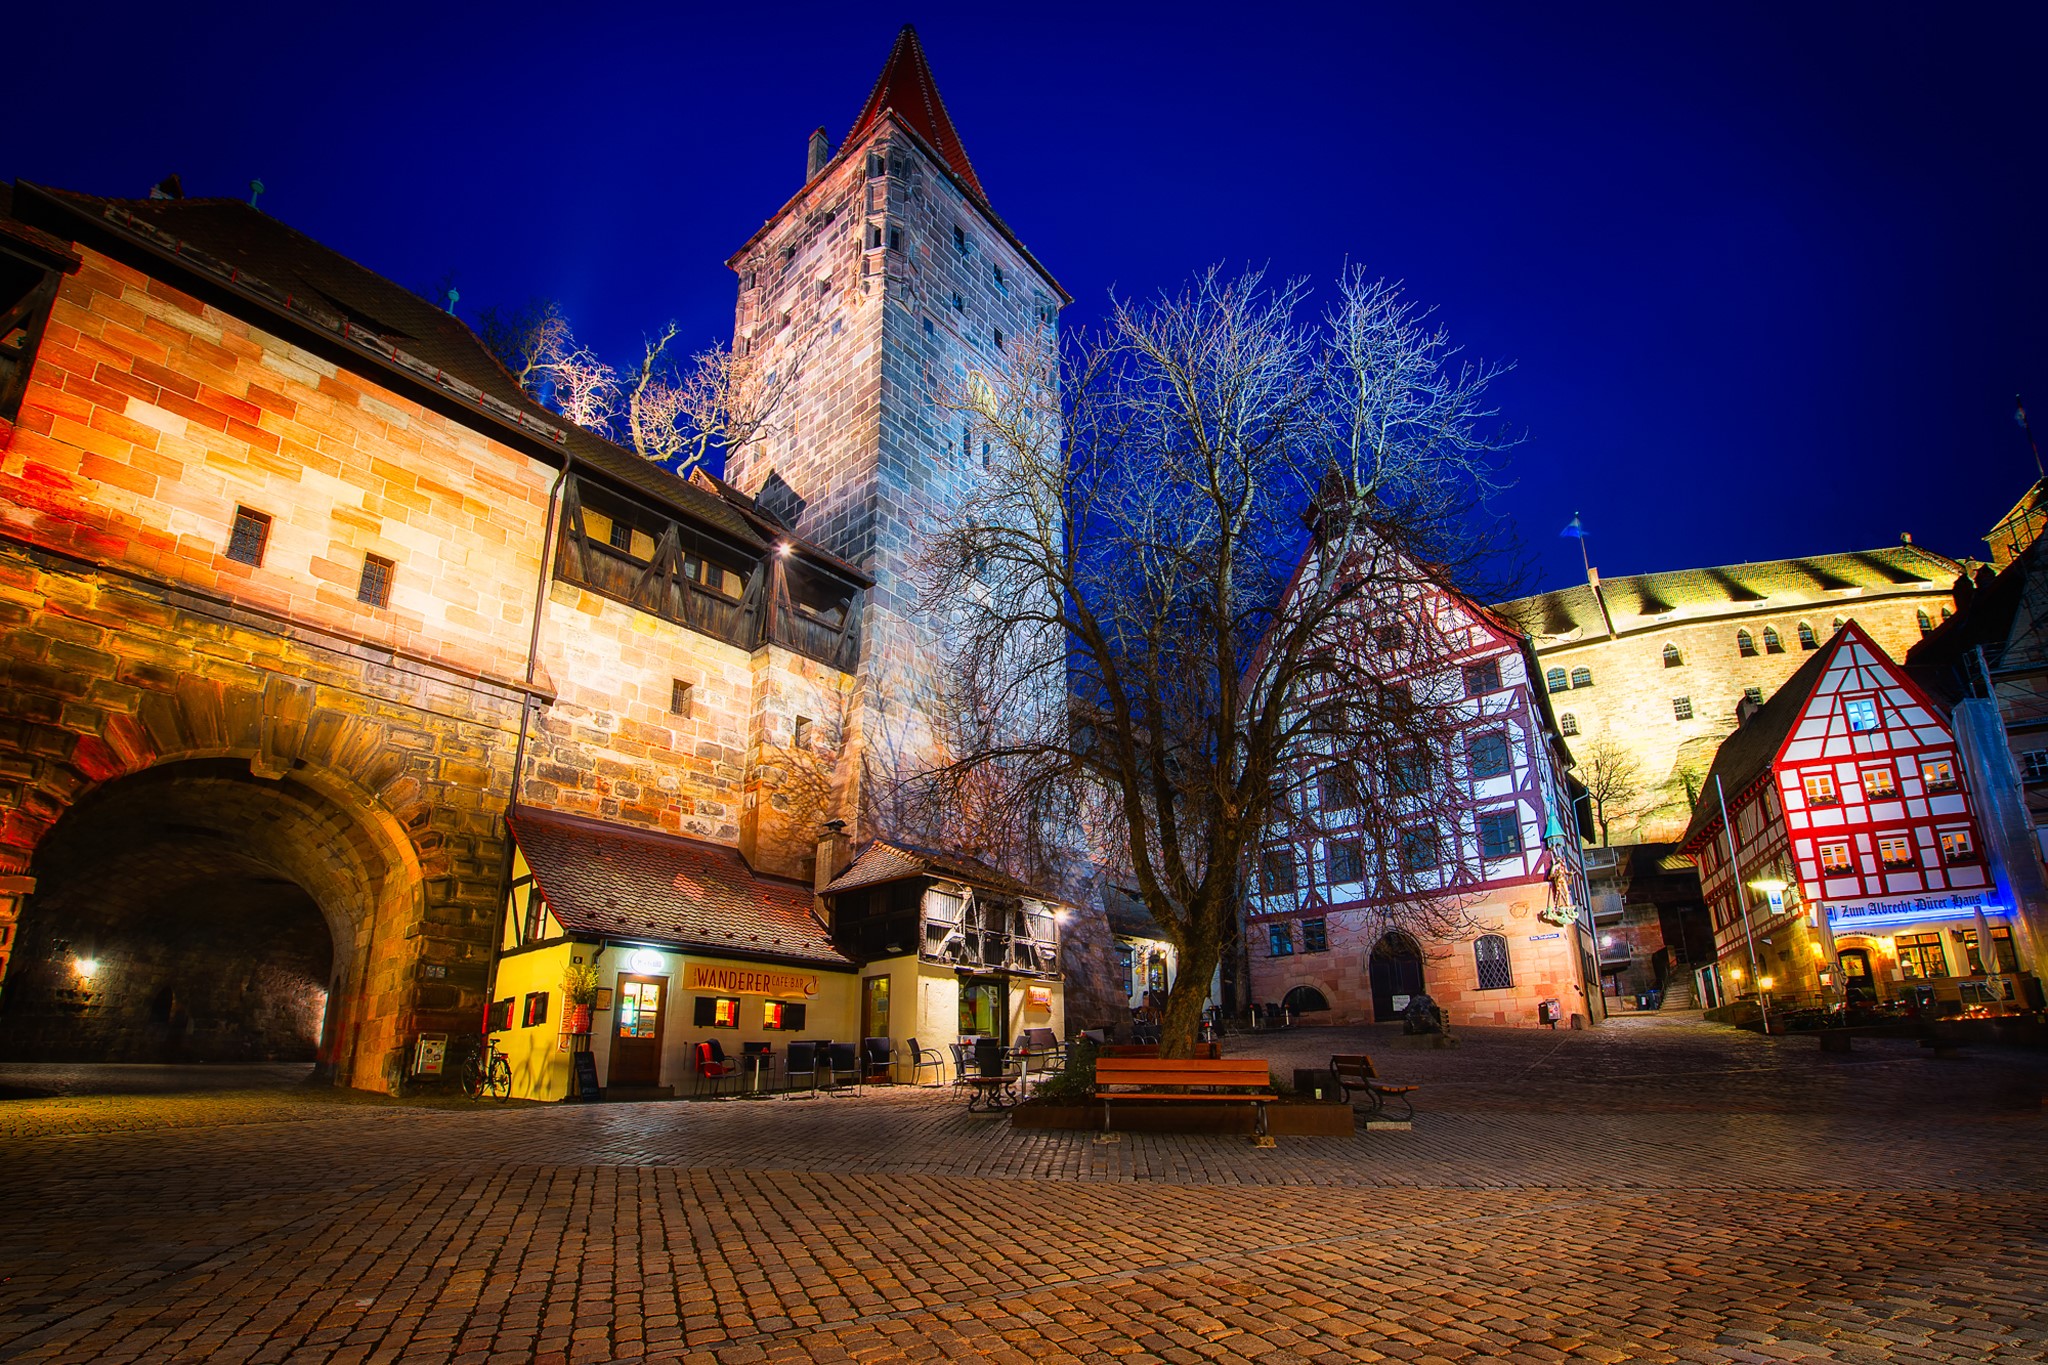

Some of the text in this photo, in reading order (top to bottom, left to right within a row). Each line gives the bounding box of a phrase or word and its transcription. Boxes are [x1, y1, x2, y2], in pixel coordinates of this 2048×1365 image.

[1841, 893, 1982, 918] Zum Albrecht Dürer Haus
[697, 967, 771, 993] WANDERER
